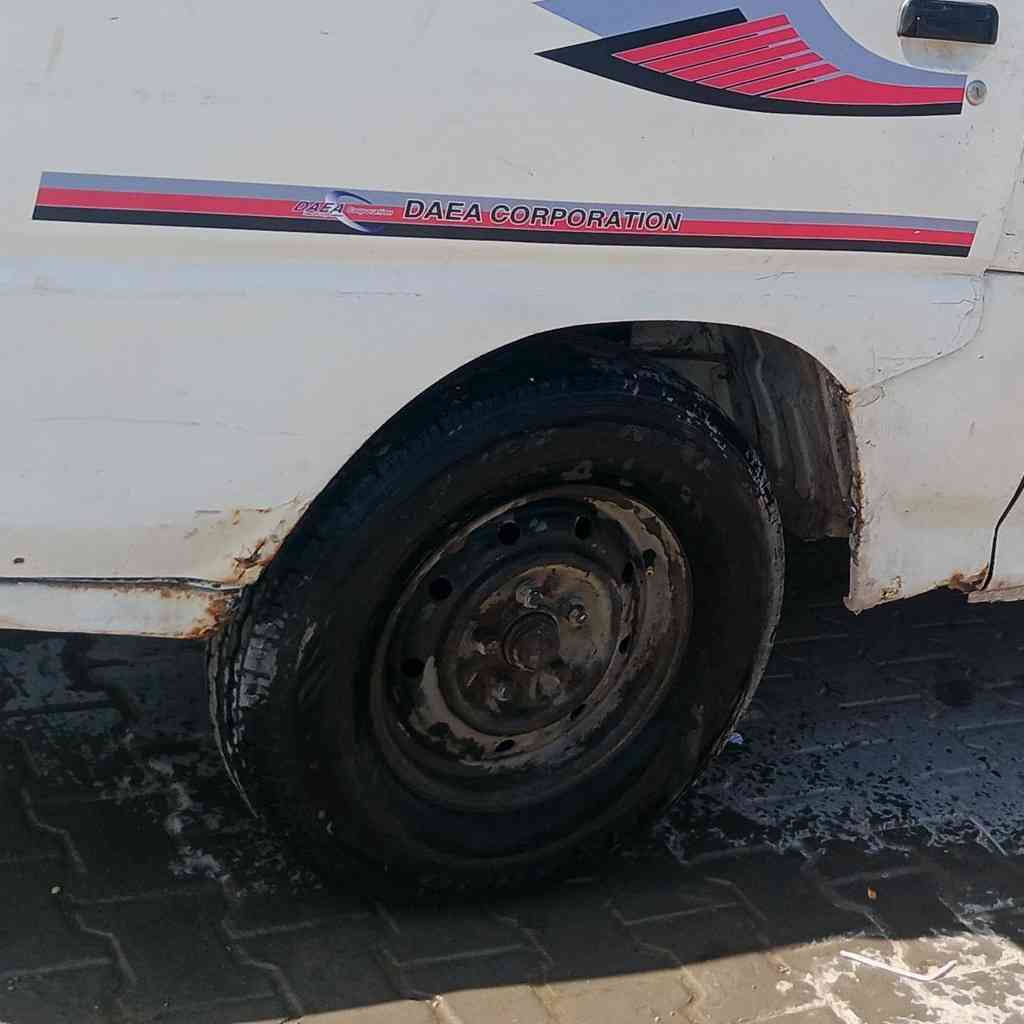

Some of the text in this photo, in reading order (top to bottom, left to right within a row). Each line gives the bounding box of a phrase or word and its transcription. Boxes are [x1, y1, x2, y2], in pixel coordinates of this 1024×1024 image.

[293, 201, 344, 214] DAEA
[404, 199, 683, 231] DAEA CORPORATION
